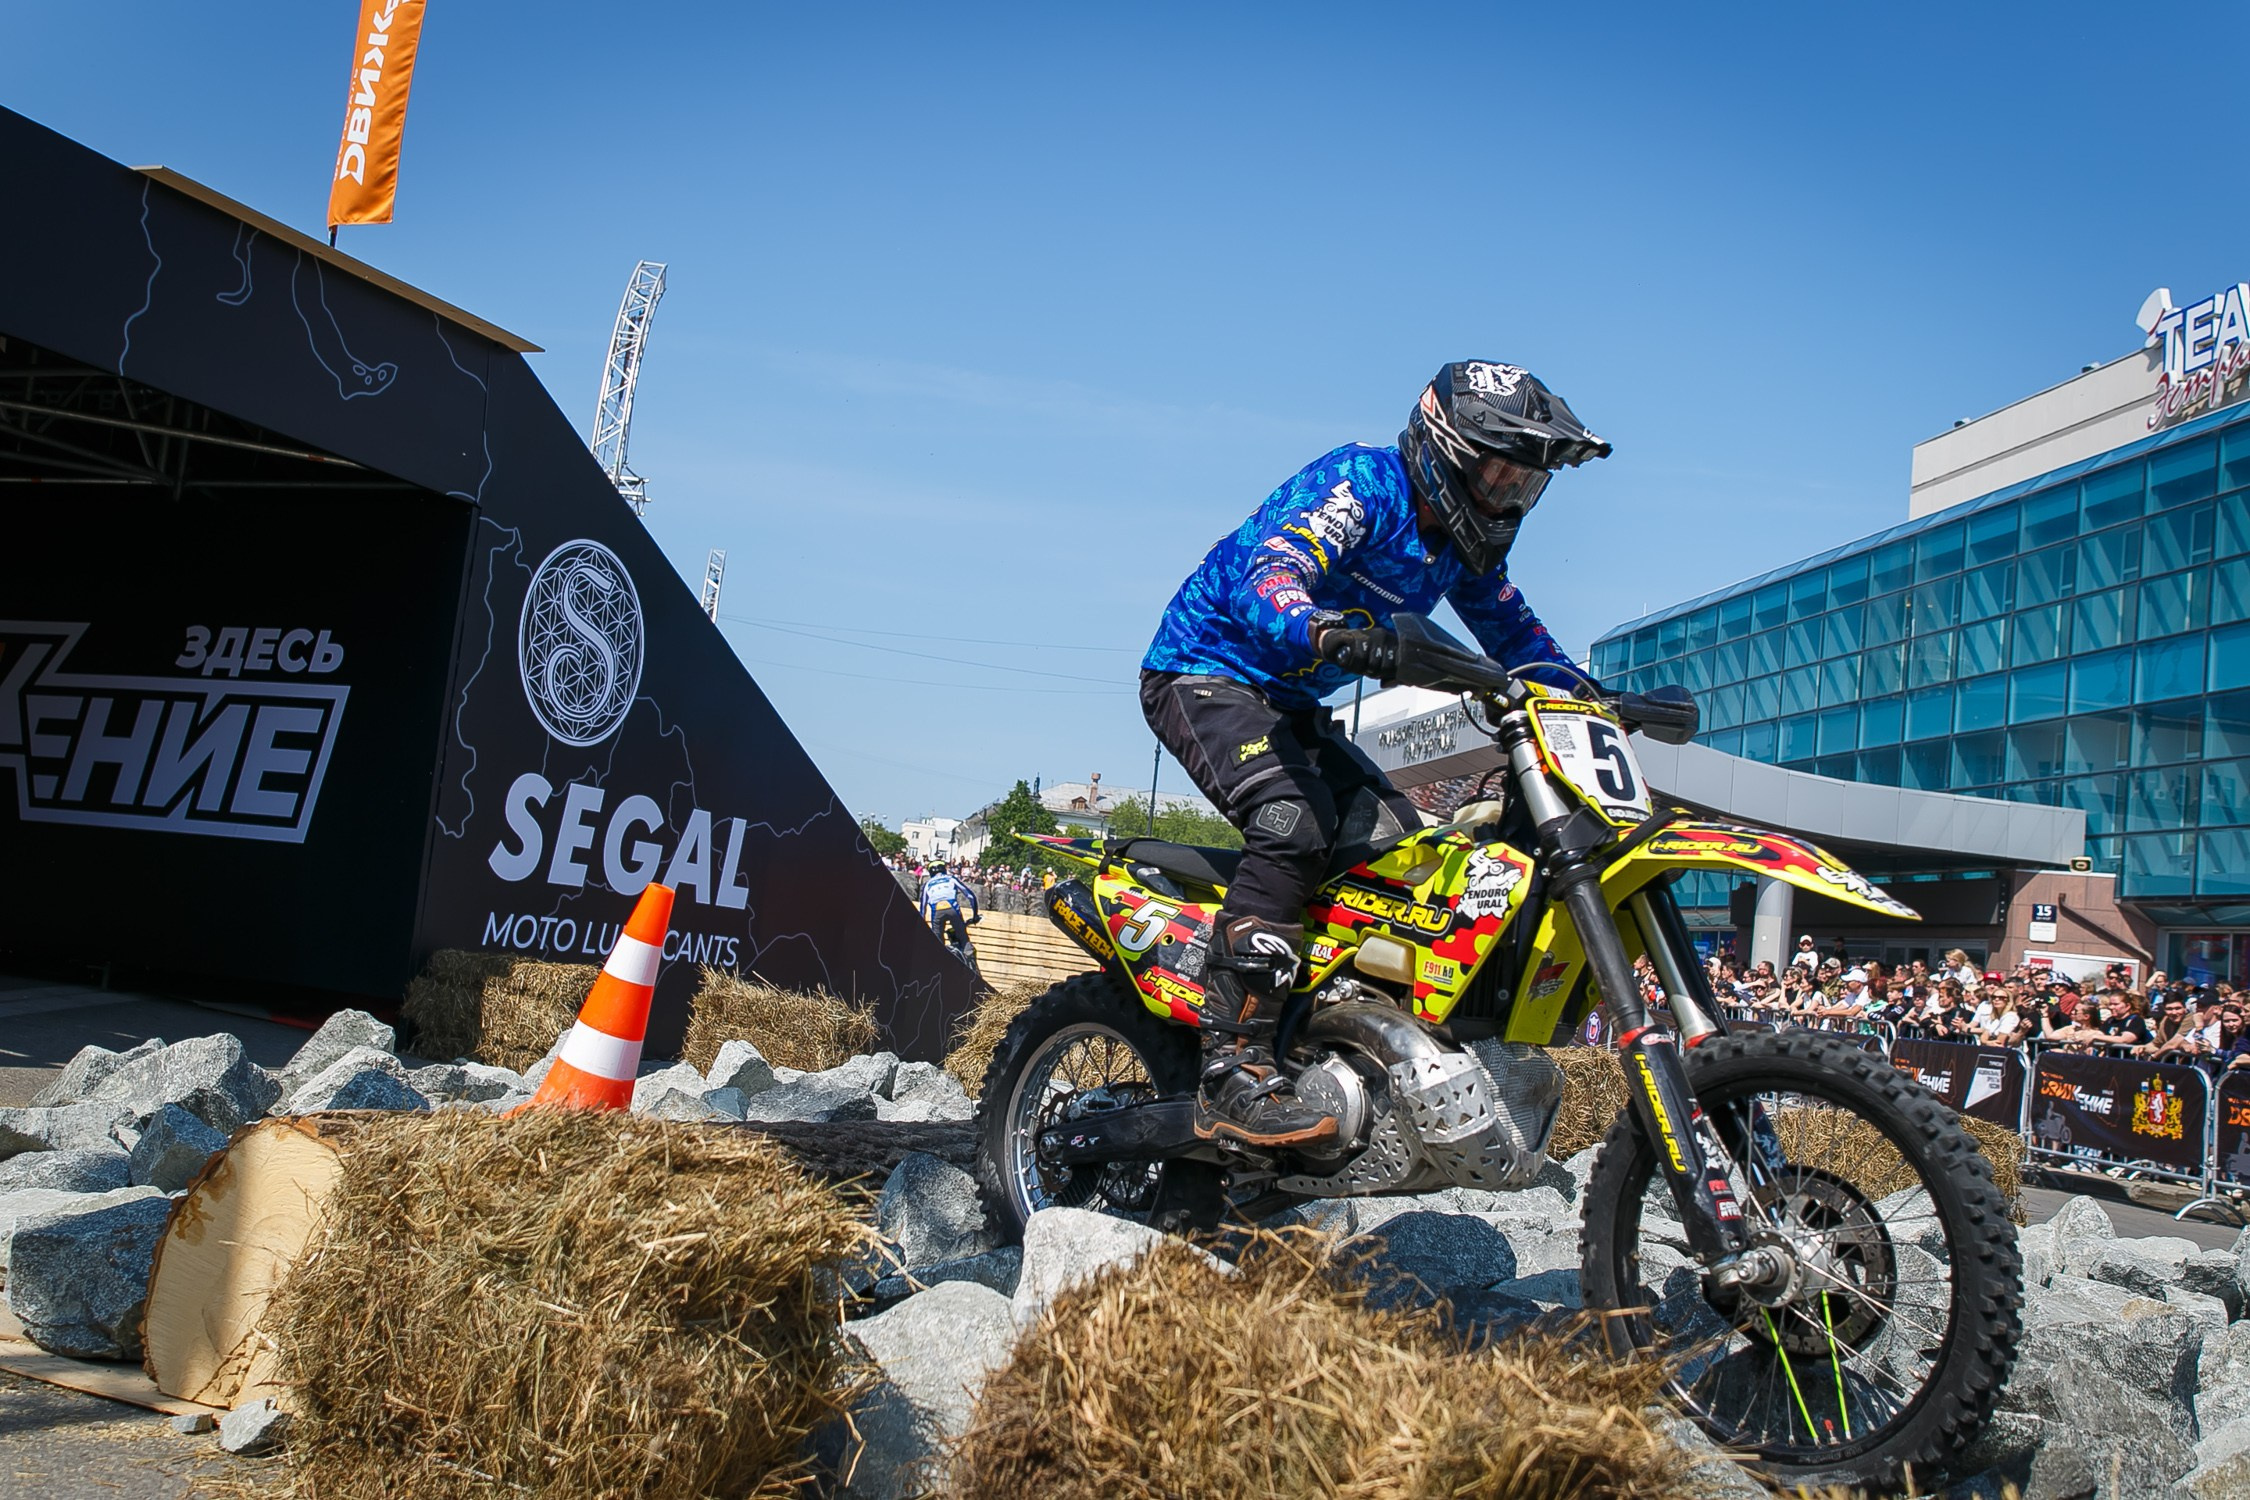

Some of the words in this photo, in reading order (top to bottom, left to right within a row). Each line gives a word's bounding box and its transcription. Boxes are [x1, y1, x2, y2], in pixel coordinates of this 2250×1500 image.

[2156, 282, 2250, 374] ТЕА
[175, 625, 344, 677] ЗДЕСЬ
[1586, 720, 1636, 801] 5
[488, 772, 749, 910] SEGAL
[1652, 839, 1763, 854] I-RIDER.RU
[1316, 884, 1452, 932] I-RIDER.RU
[1468, 888, 1509, 899] ENDURO
[1477, 899, 1503, 909] URAL
[2036, 905, 2052, 916] 15
[482, 911, 577, 949] MOTO
[582, 920, 740, 967] LUCANTS
[1053, 899, 1087, 934] RACE
[1085, 925, 1116, 960] TECH
[1118, 899, 1180, 951] 5
[1143, 970, 1205, 1007] I-RIDE
[1634, 1054, 1688, 1172] I-RIDER.RU
